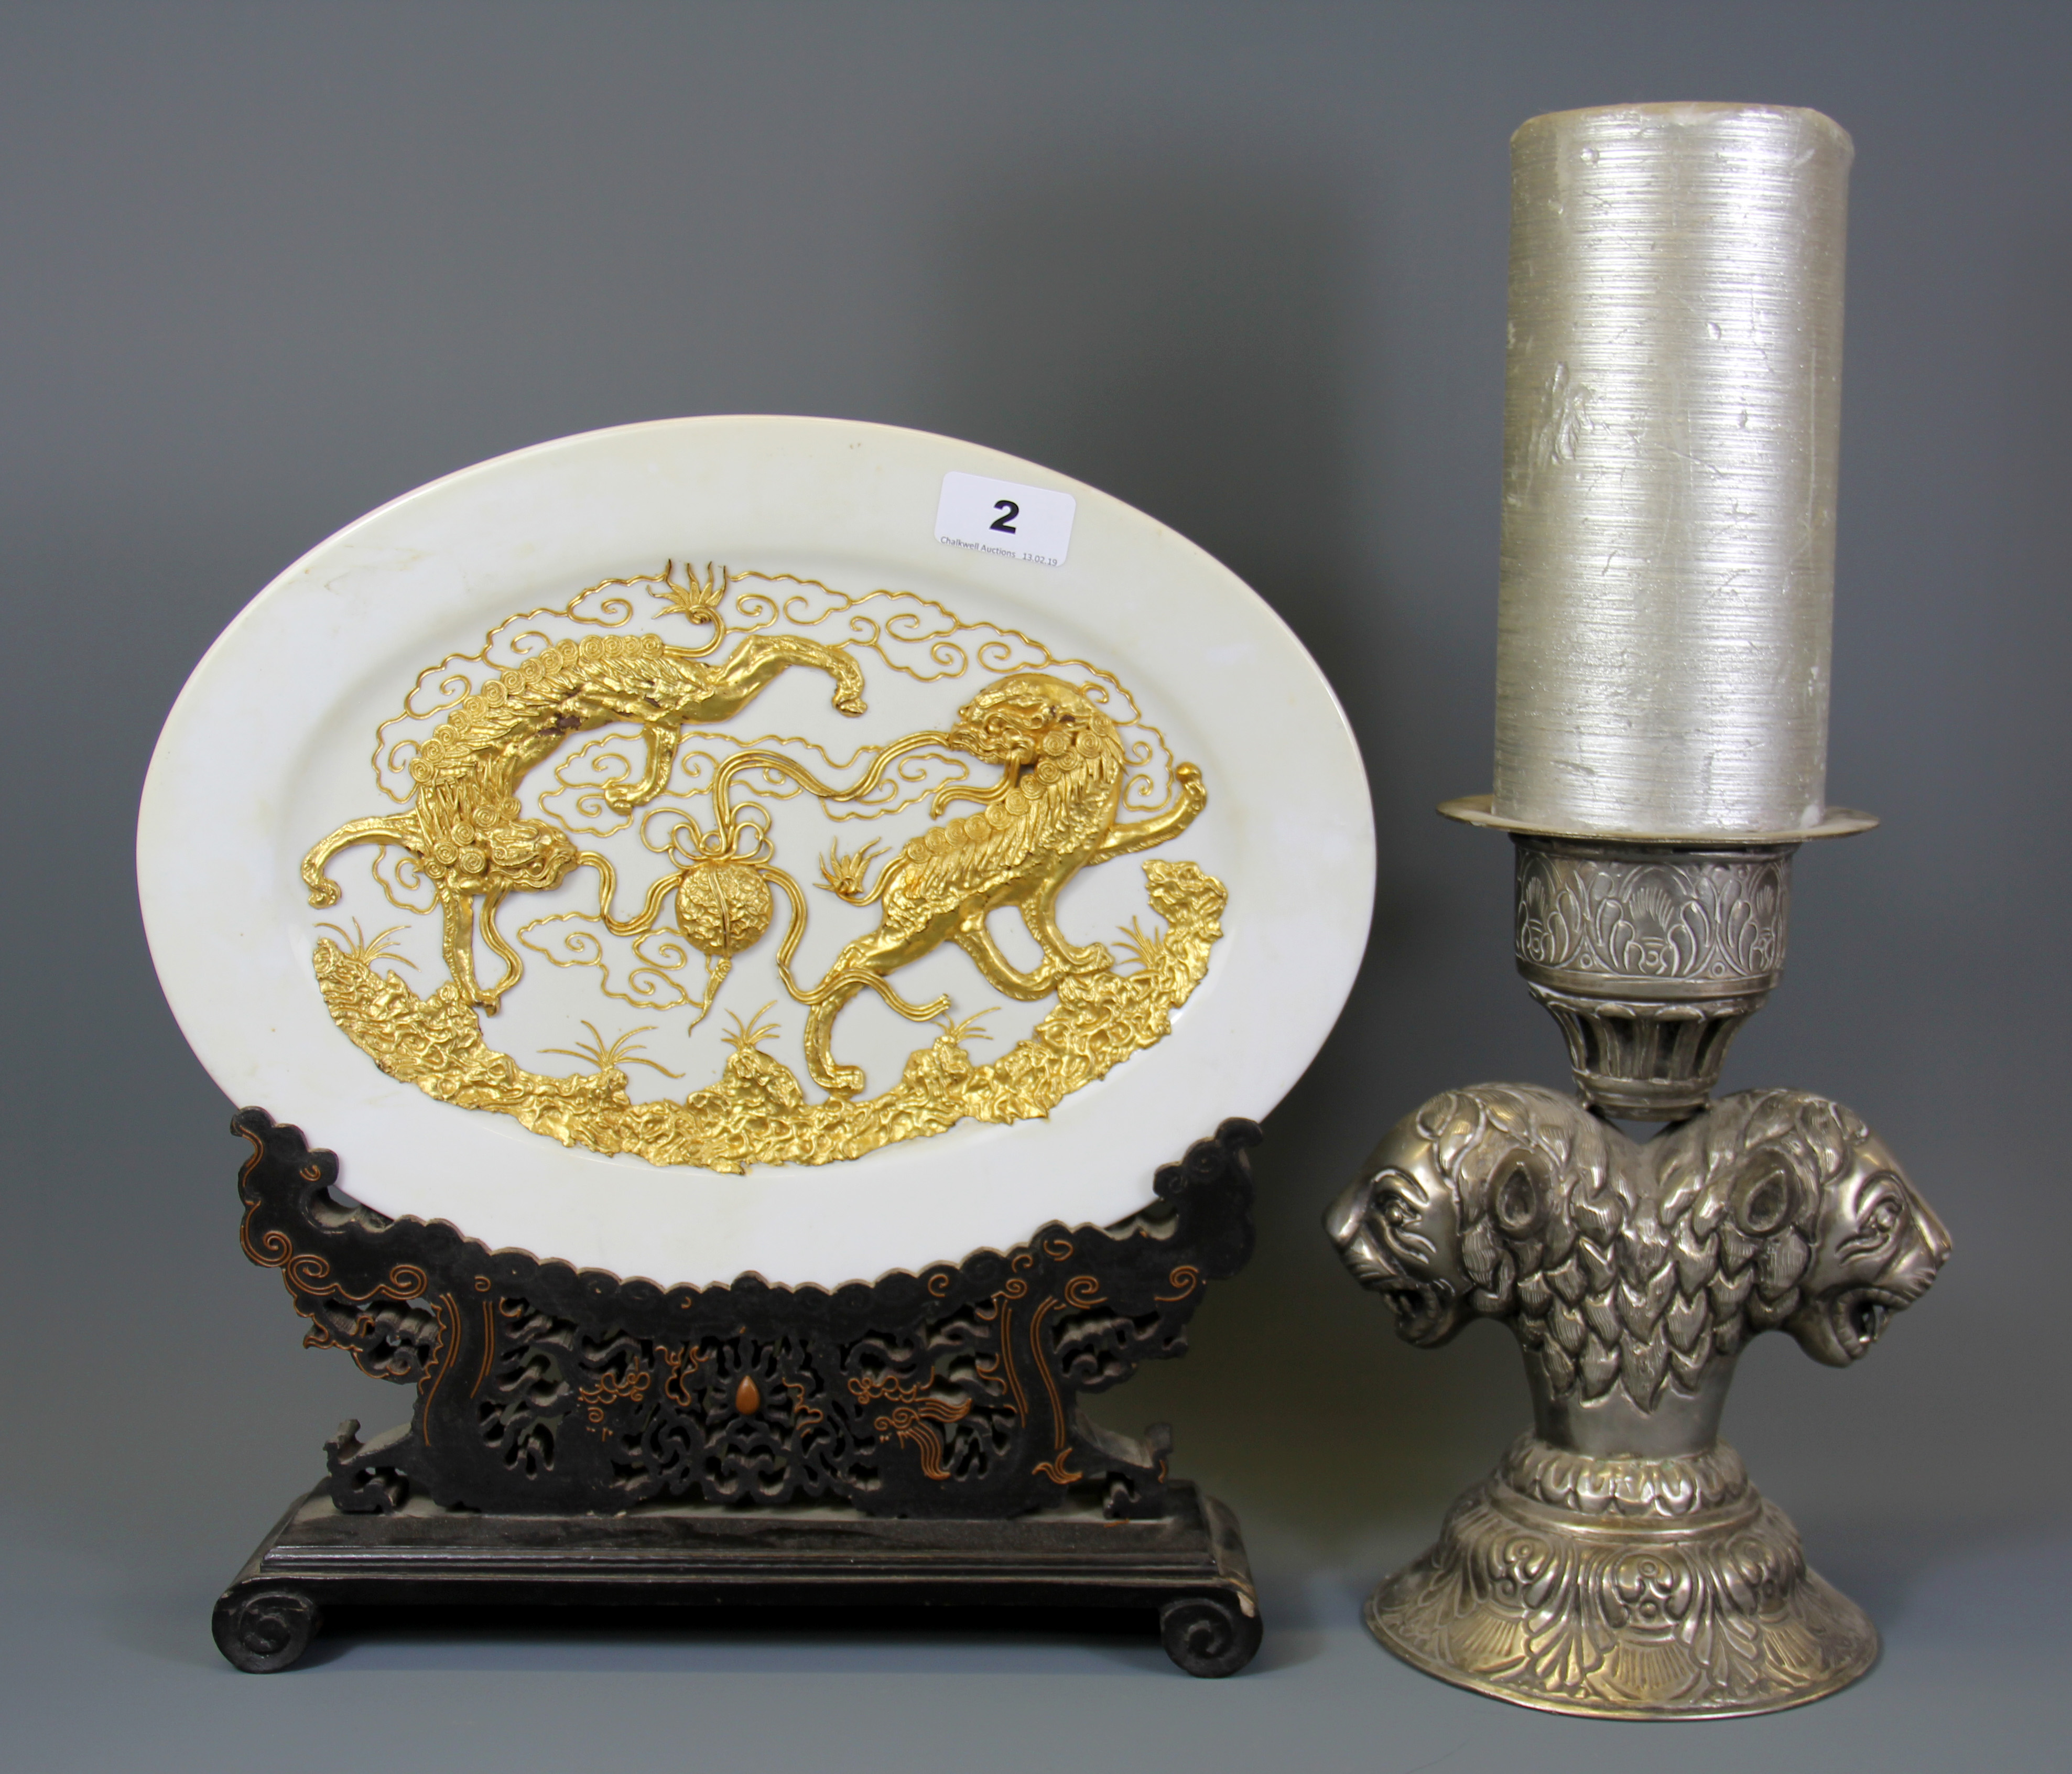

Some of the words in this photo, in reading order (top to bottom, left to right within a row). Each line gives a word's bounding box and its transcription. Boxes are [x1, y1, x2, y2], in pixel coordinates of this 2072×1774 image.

[989, 500, 1019, 534] 2
[940, 536, 979, 550] Chalkwell
[981, 544, 1016, 558] Auctions
[1022, 553, 1058, 566] 13.02.19
